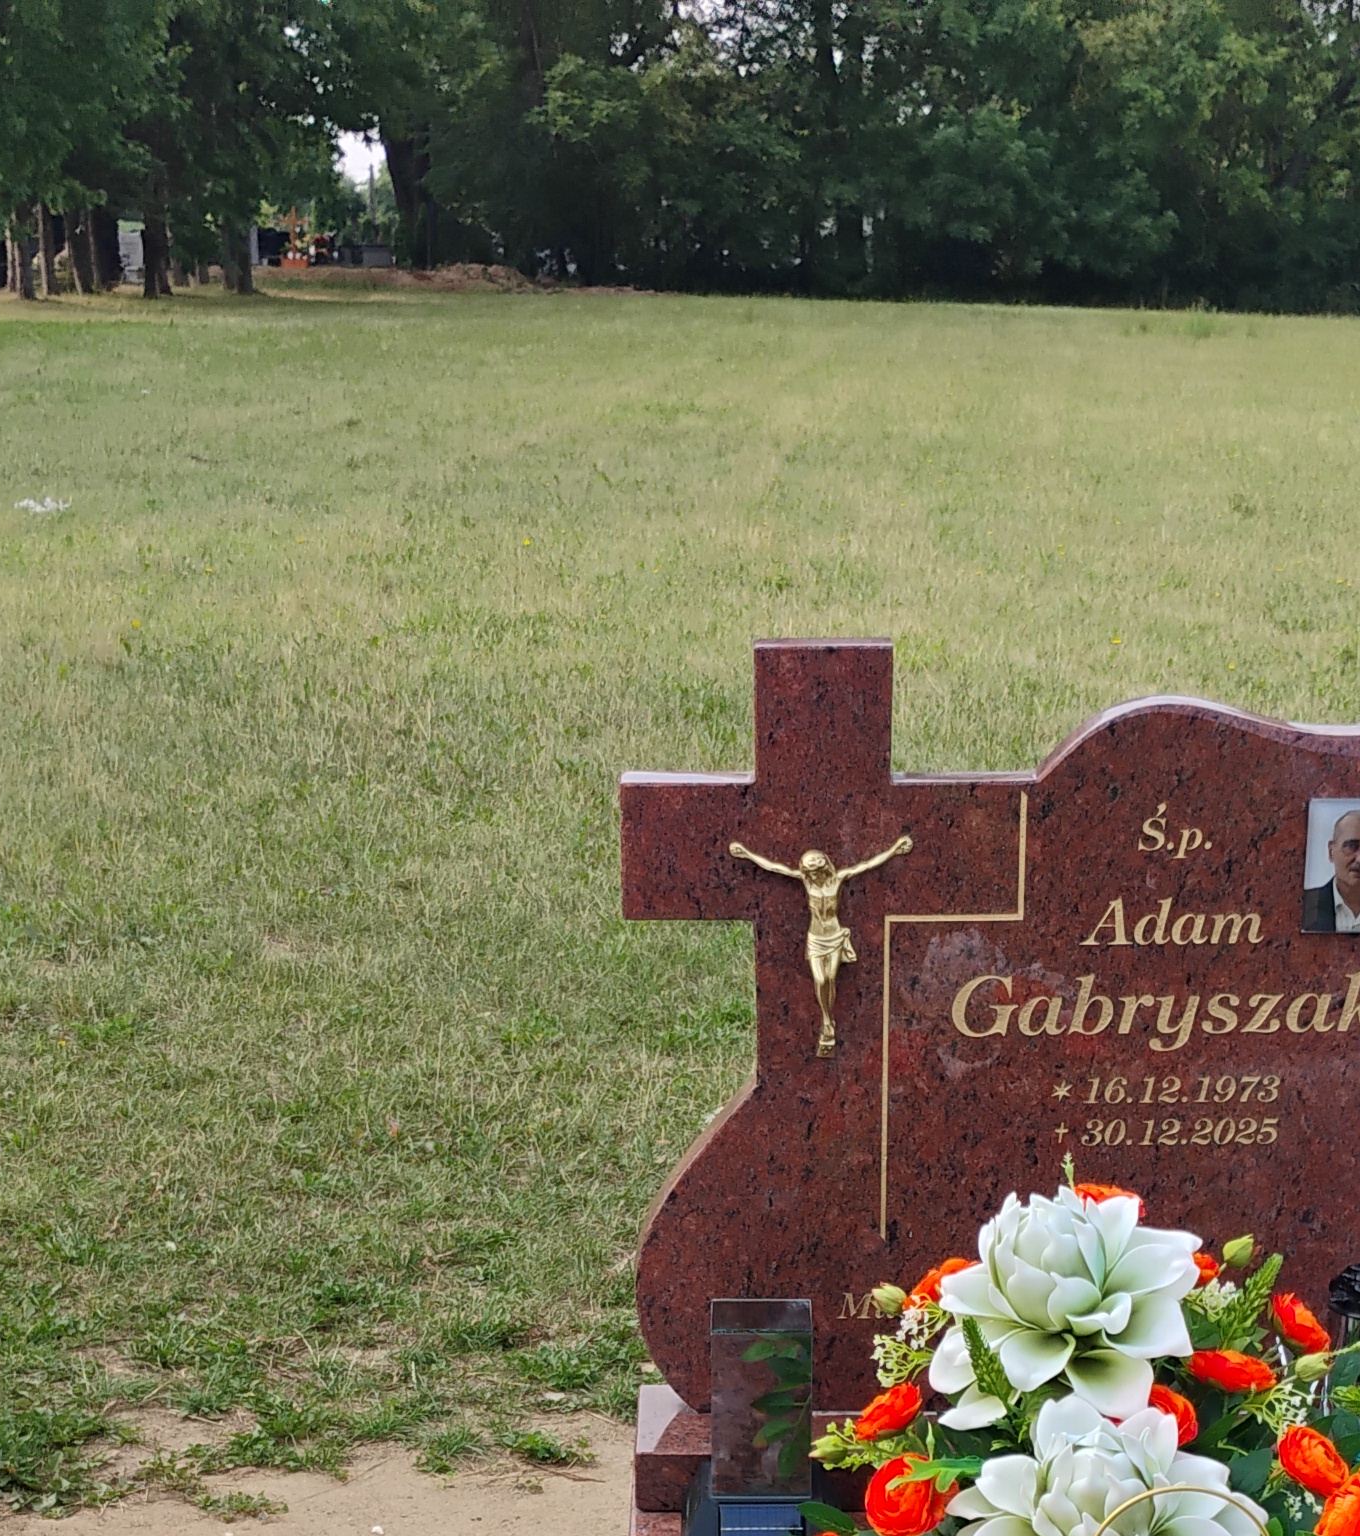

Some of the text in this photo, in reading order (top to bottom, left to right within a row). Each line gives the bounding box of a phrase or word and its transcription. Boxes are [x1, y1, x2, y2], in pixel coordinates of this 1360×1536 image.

[1137, 802, 1213, 859] Ś.p.
[1079, 896, 1264, 946] Adam
[1085, 1074, 1281, 1105] 16.12.1973
[1080, 1117, 1279, 1146] 30.12.2025
